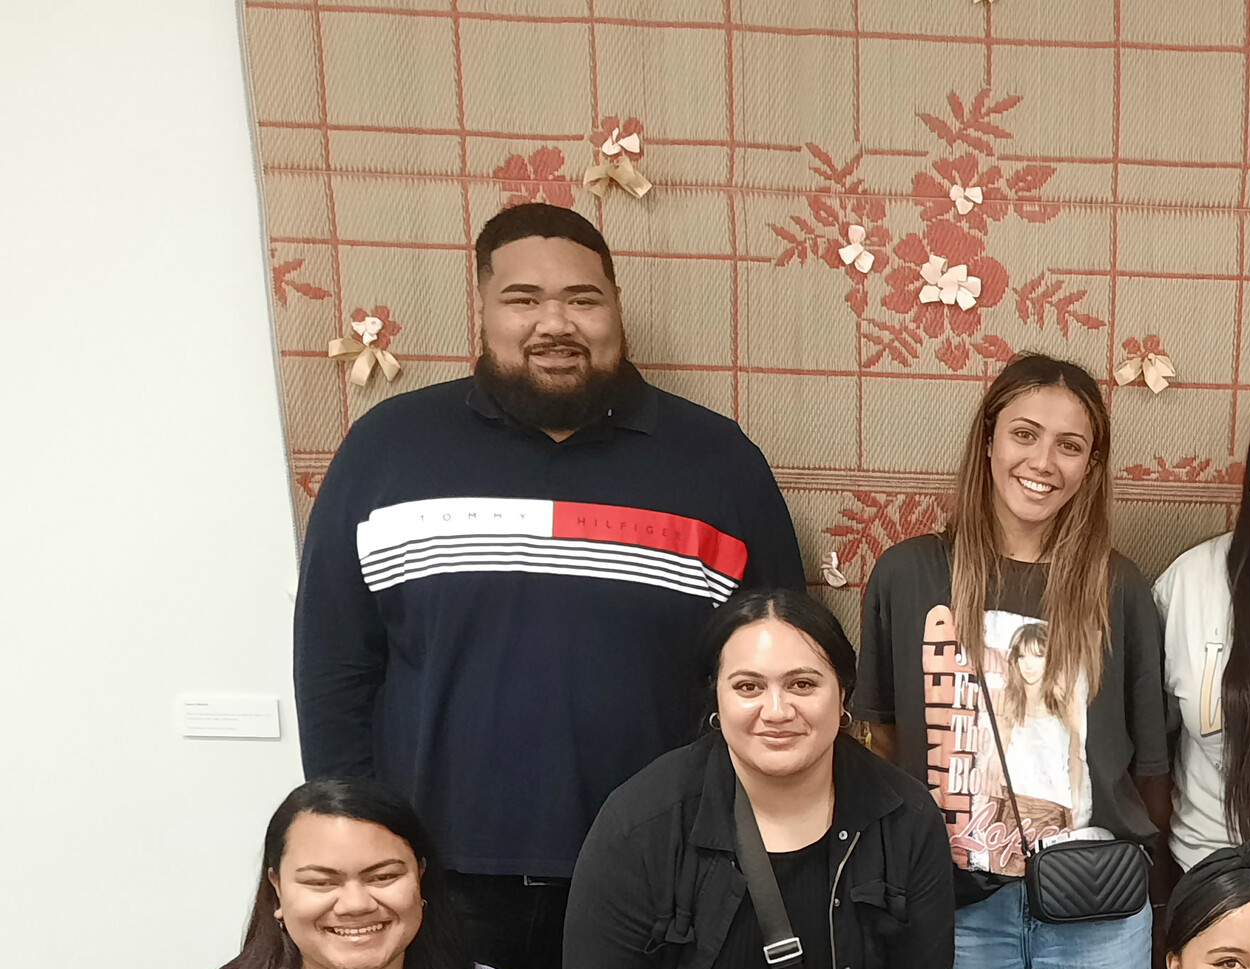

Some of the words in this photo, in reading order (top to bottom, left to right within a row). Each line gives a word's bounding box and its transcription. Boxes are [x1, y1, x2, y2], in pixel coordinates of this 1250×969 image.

[419, 512, 526, 523] TOMMY
[951, 713, 992, 757] The
[950, 802, 1072, 868] Lope
